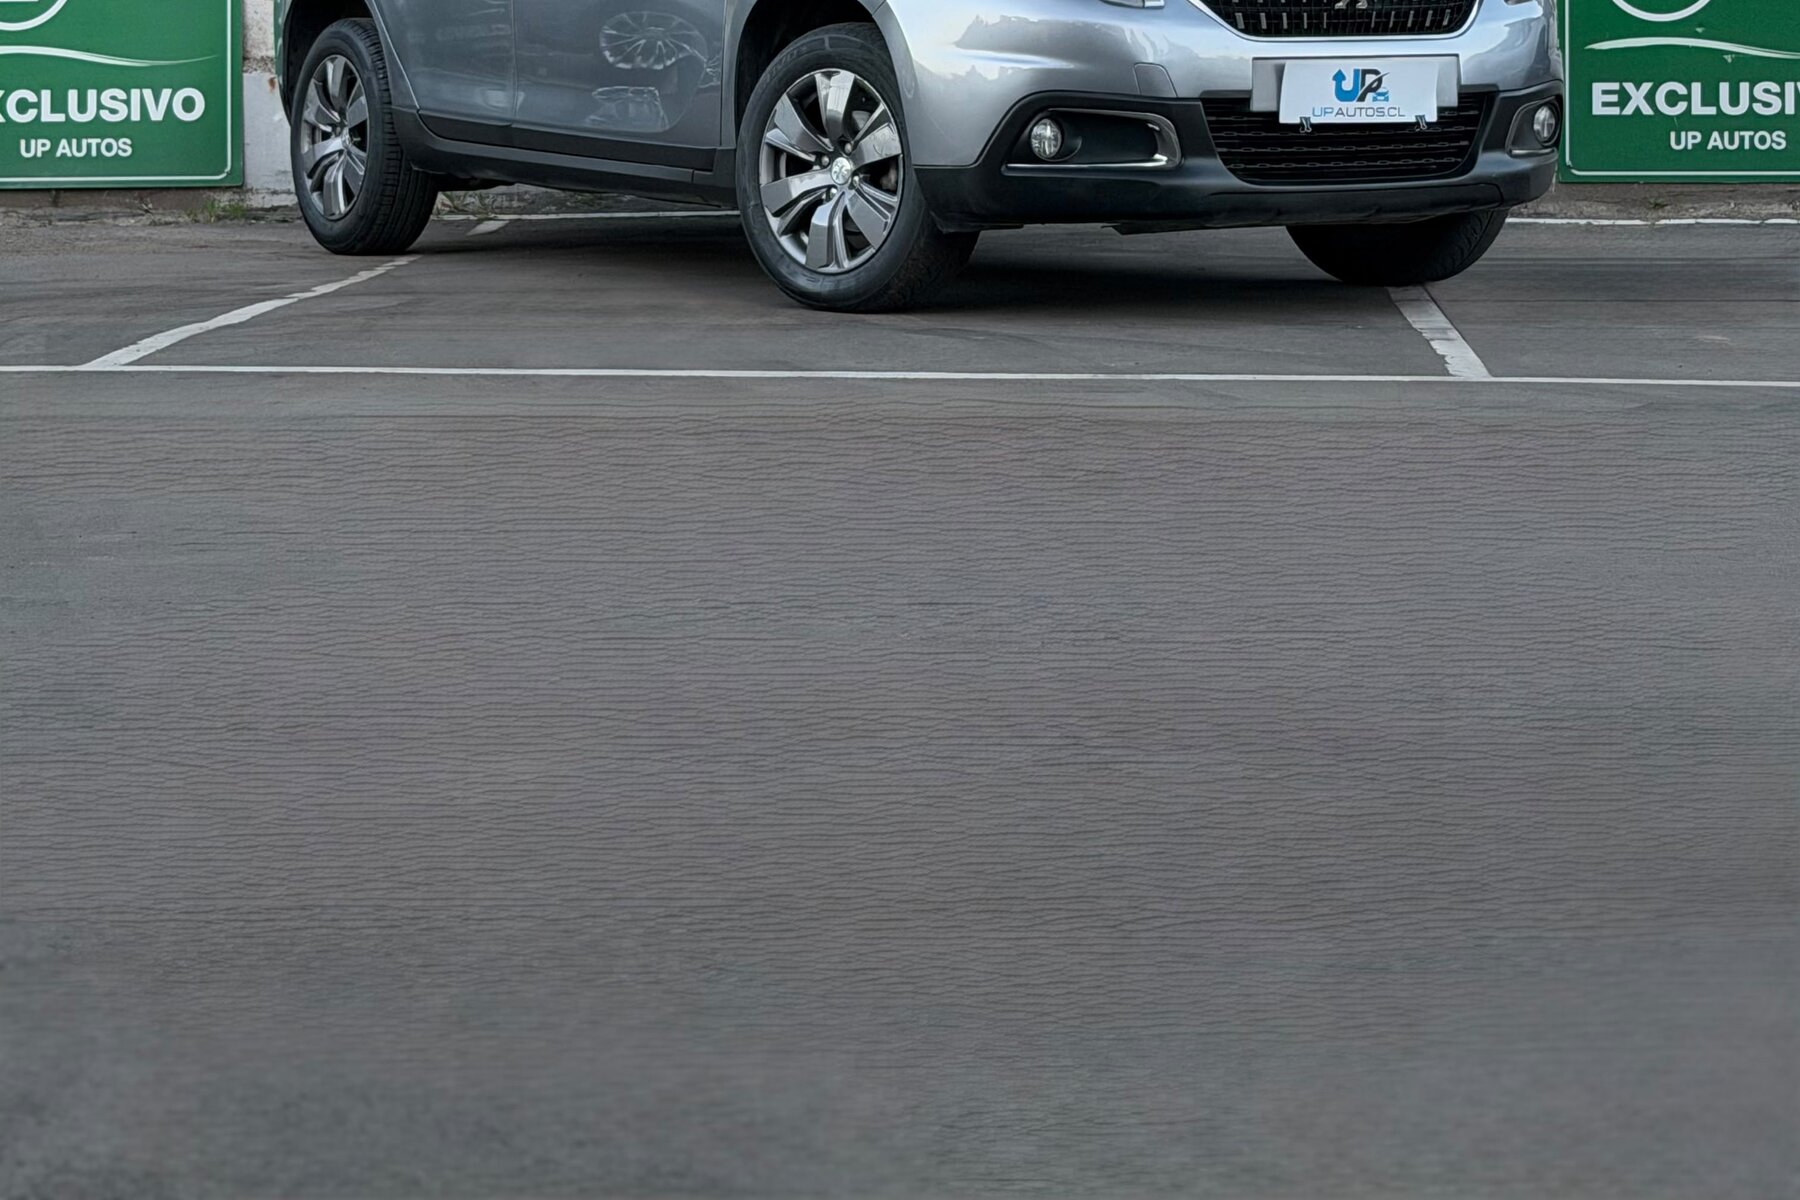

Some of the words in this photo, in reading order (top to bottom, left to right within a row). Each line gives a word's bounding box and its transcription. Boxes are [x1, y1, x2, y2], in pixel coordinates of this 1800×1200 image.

[0, 87, 206, 123] CLUSIVO
[1591, 81, 1800, 115] EXCLUSI
[20, 139, 51, 158] UP
[56, 138, 133, 157] AUTOS
[1669, 131, 1702, 150] UP
[1707, 130, 1787, 150] AUTOS
